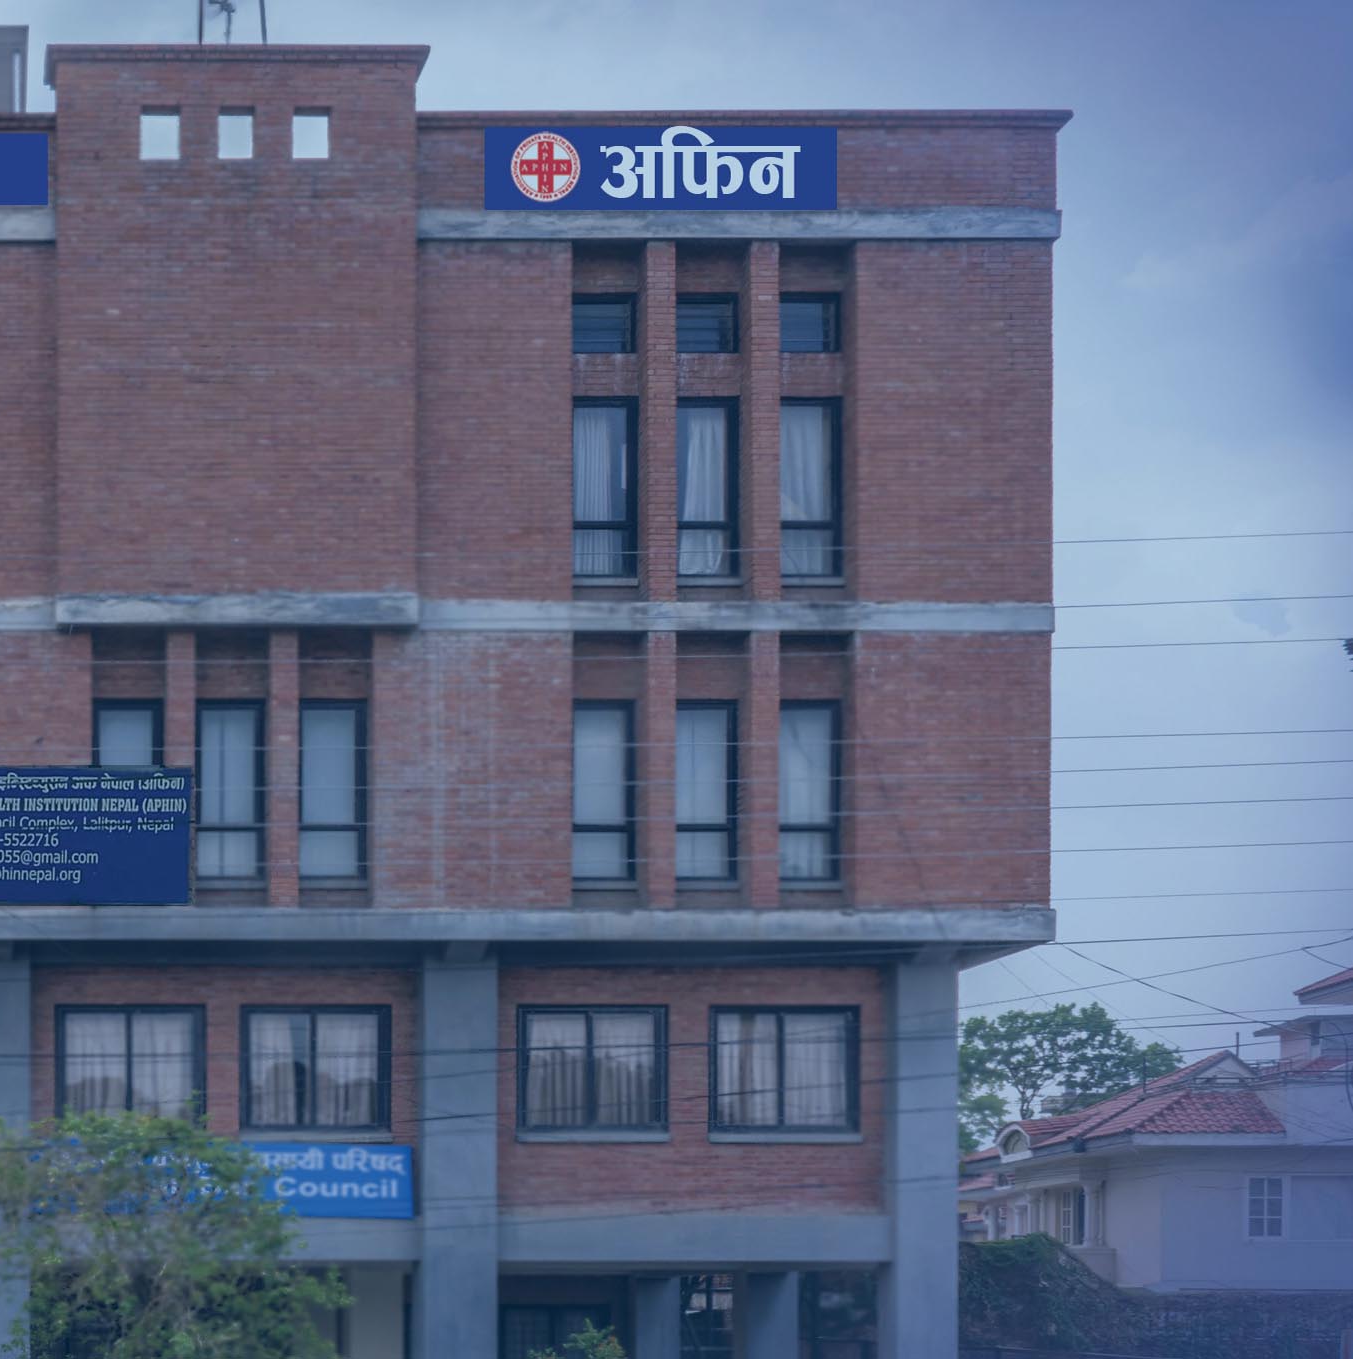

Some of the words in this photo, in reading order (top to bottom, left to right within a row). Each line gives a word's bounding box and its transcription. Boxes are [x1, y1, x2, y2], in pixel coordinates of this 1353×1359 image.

[600, 125, 801, 199] अफिन
[24, 798, 98, 811] INSTITUTION
[102, 798, 138, 812] NEPAL
[142, 798, 186, 814] (APHIN)
[20, 816, 77, 832] Complex,
[138, 817, 173, 833] Nepal
[274, 1175, 398, 1198] Council
